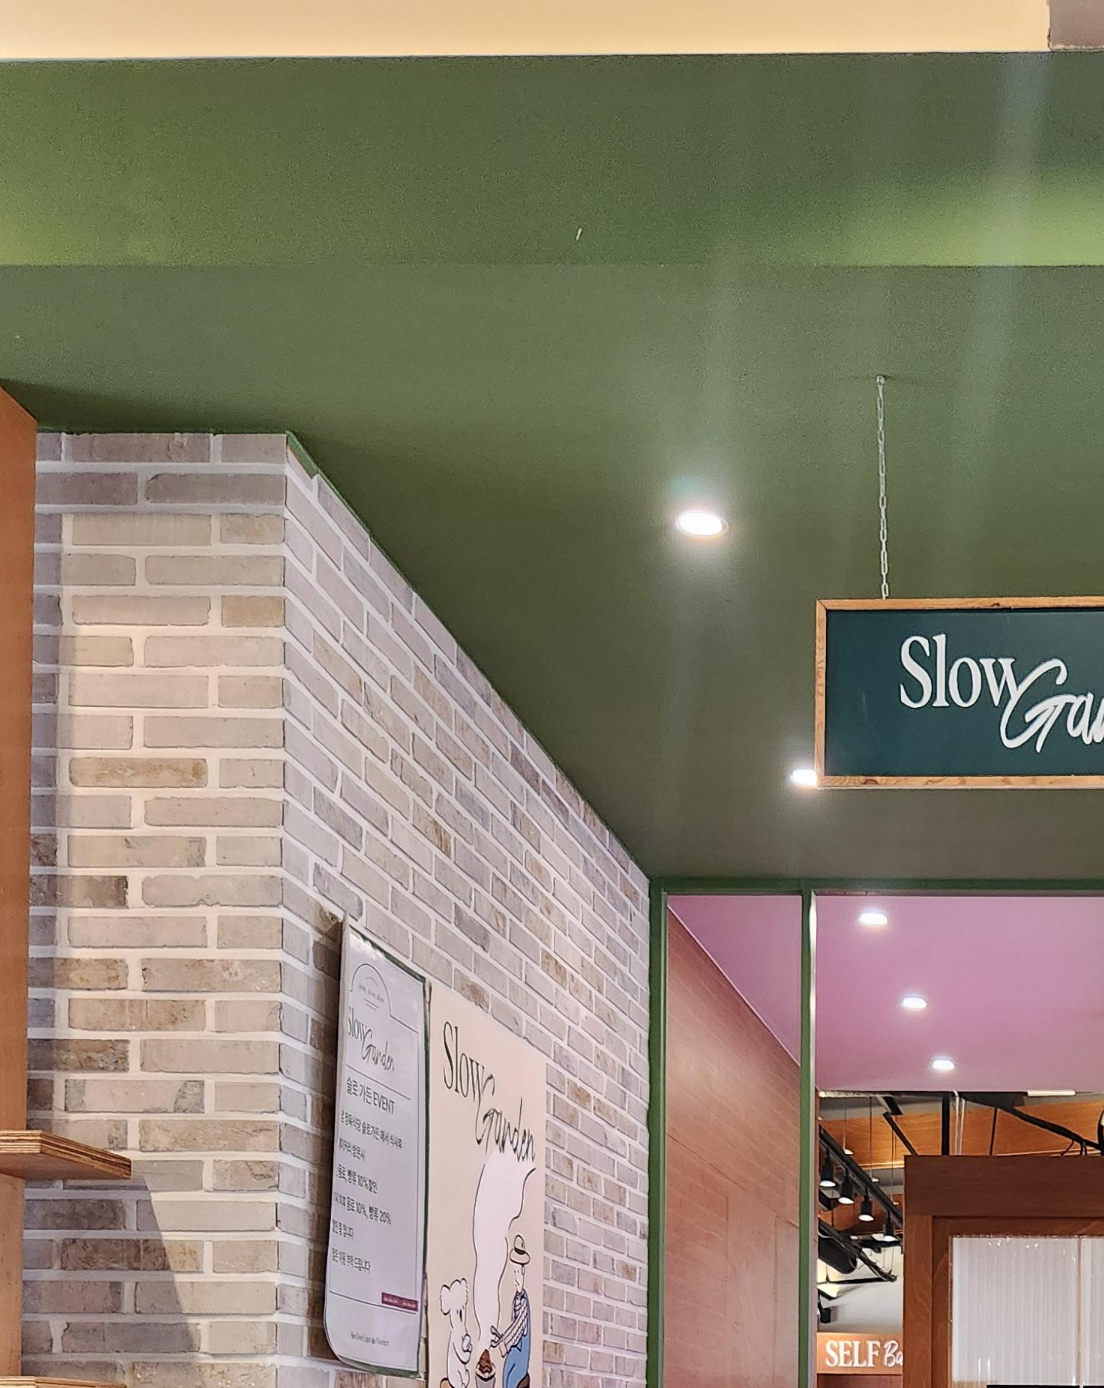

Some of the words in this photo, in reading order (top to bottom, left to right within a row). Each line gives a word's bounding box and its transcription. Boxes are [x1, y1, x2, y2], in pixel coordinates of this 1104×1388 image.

[900, 634, 1015, 708] Slow
[373, 1091, 395, 1114] EVENT
[443, 1021, 485, 1103] Slow
[475, 1073, 536, 1163] Garden
[825, 1340, 880, 1367] SELF
